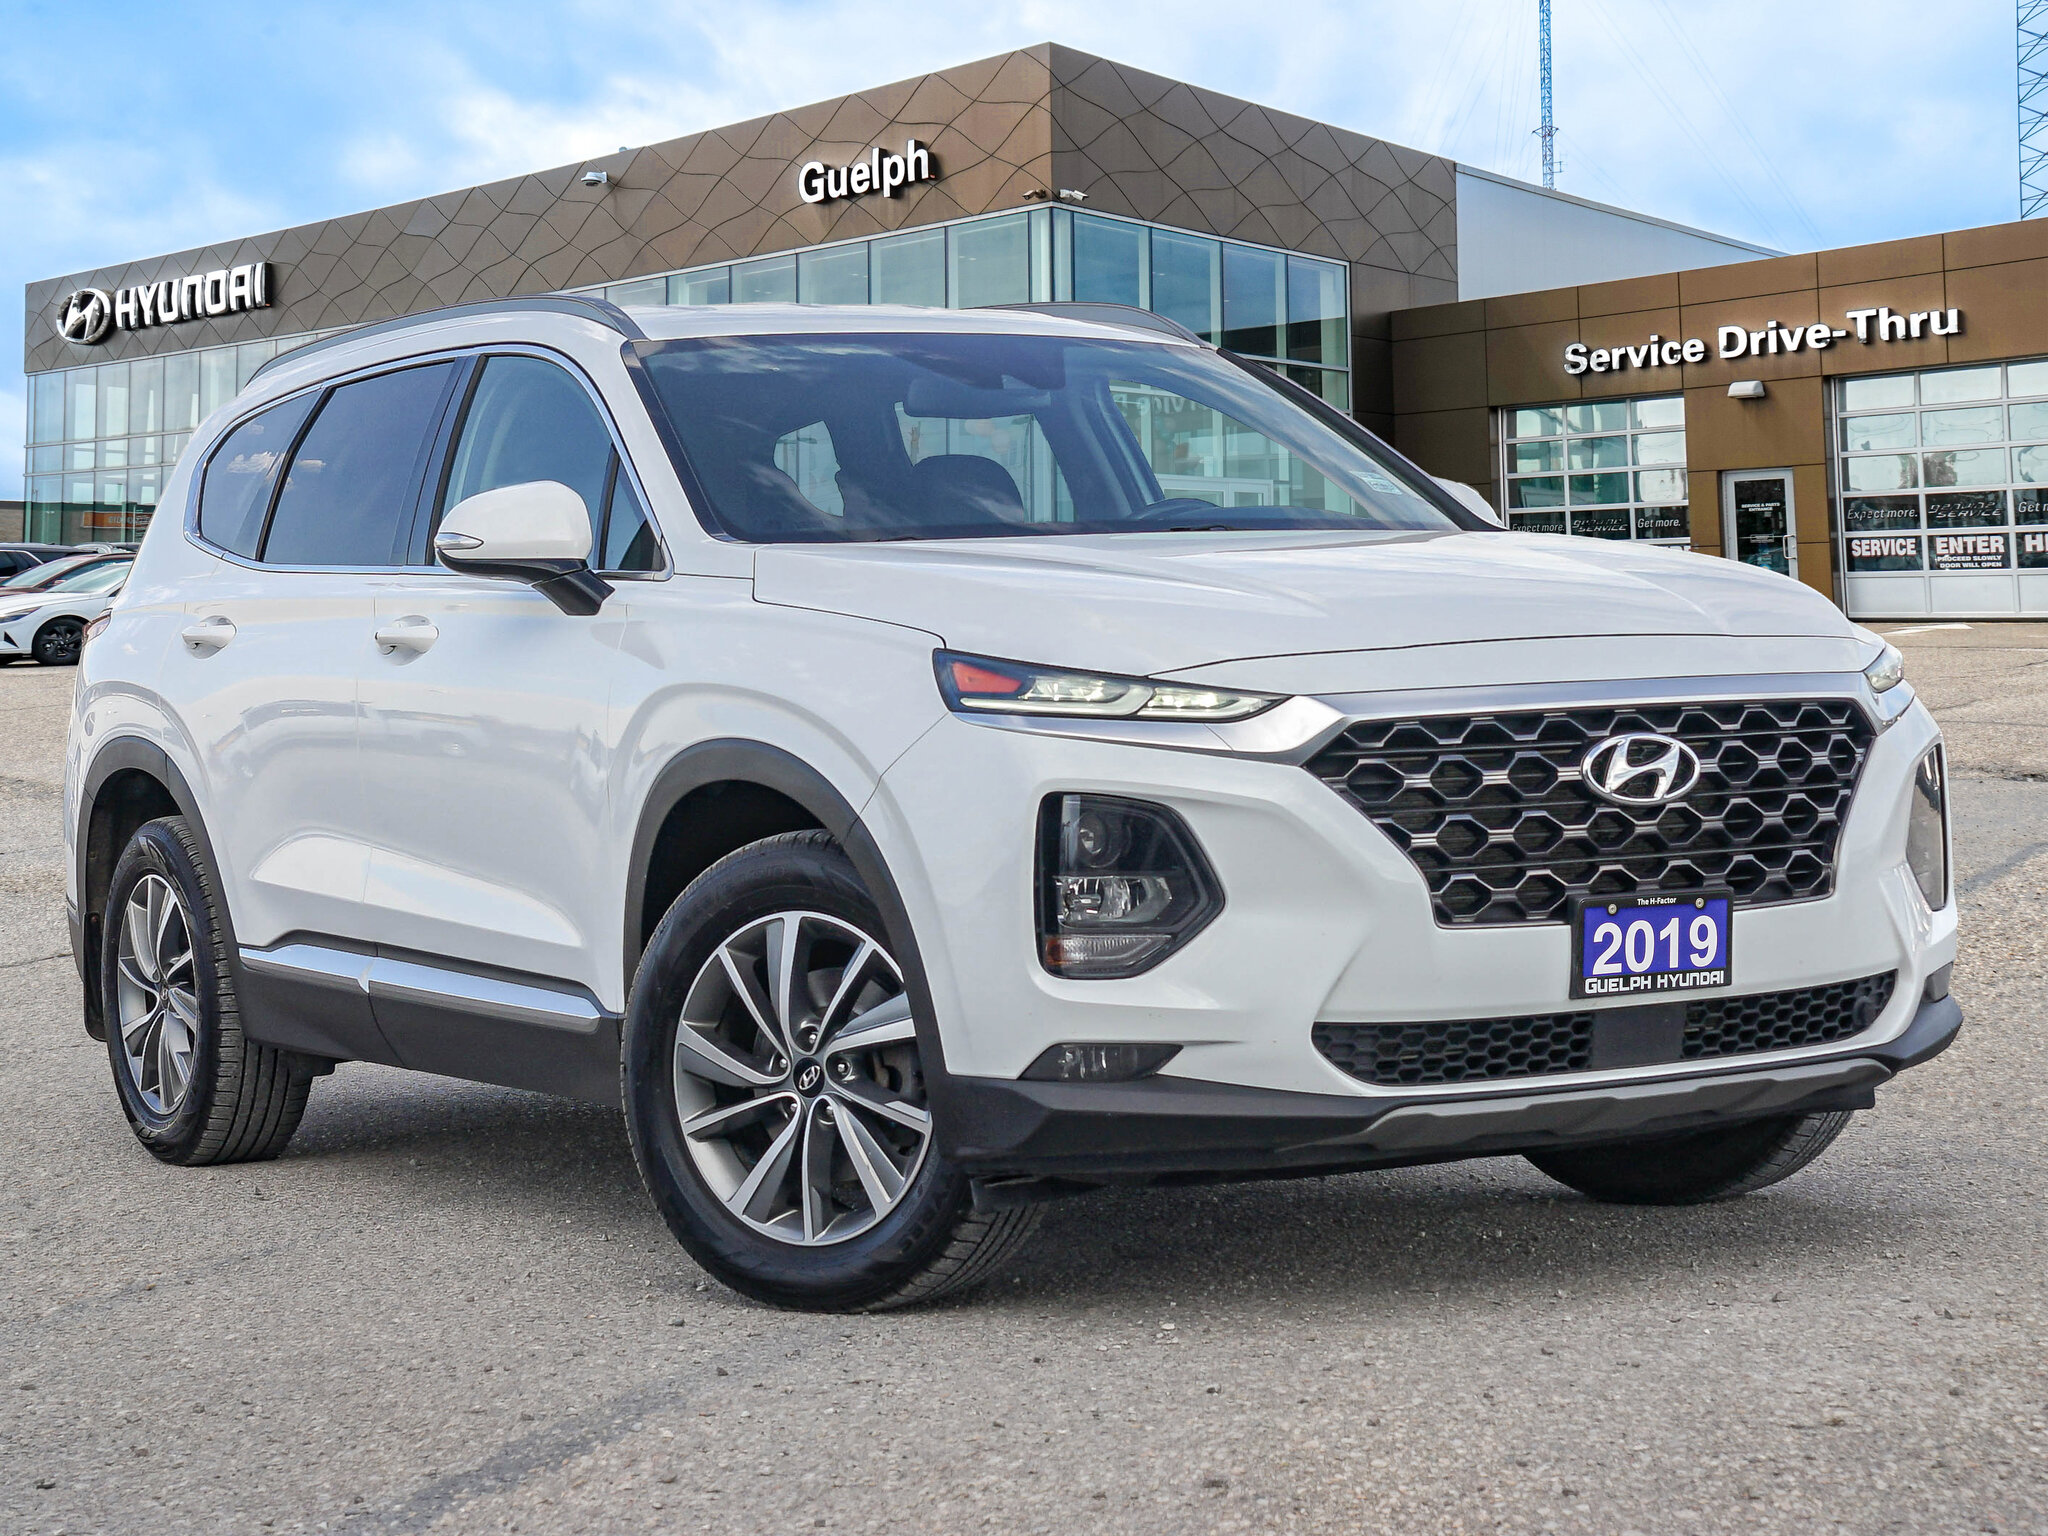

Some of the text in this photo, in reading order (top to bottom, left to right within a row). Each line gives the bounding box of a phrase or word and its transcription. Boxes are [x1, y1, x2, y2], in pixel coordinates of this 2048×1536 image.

[799, 139, 930, 203] Guelph
[115, 262, 270, 330] HYUNDAI
[1563, 307, 1961, 375] Service Drive-Thru
[1847, 508, 1918, 521] Expect more.
[1936, 508, 2003, 518] SERVICE
[2018, 501, 2040, 513] Get
[1541, 523, 1565, 532] more.
[1637, 518, 1681, 528] Get more.
[1851, 537, 1917, 557] SERVICE
[1935, 535, 2005, 555] ENTER
[1637, 897, 1677, 906] The H-Factor
[1592, 915, 1718, 975] 2019
[1584, 970, 1725, 994] GUELPH HYUNDAI
